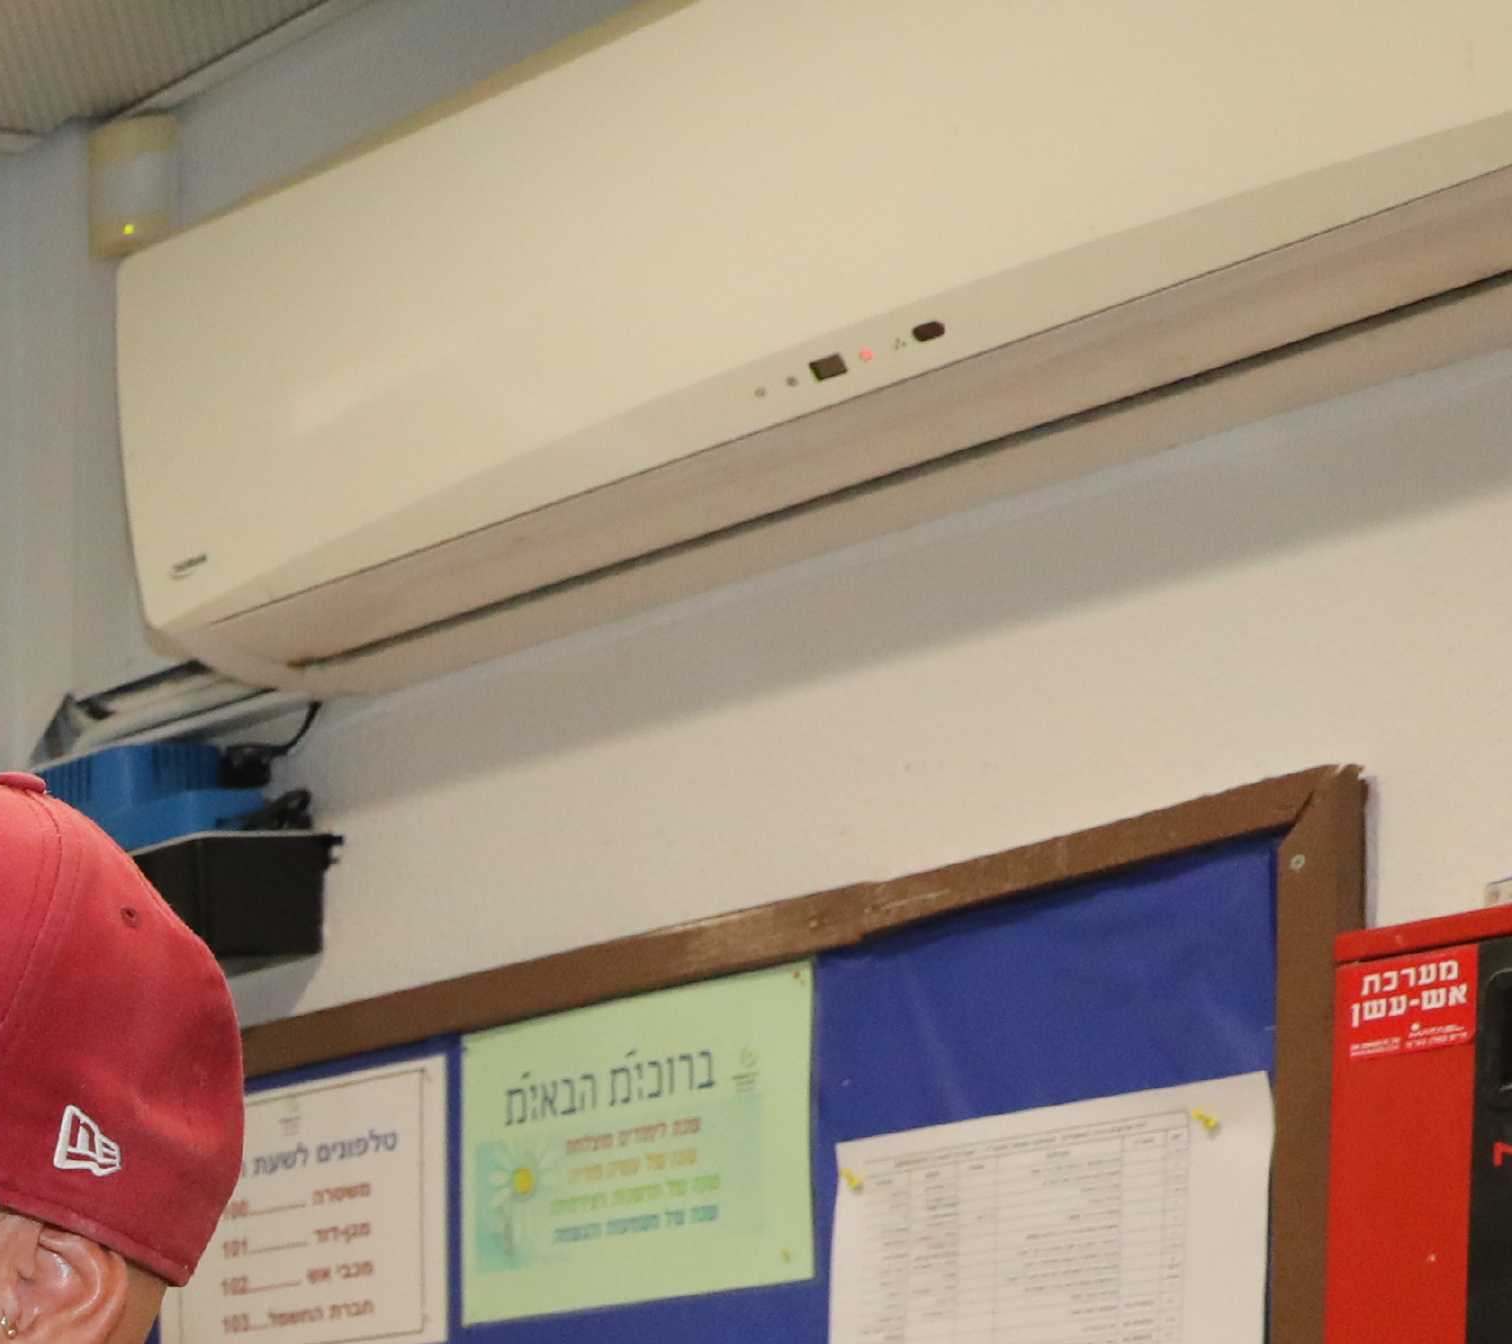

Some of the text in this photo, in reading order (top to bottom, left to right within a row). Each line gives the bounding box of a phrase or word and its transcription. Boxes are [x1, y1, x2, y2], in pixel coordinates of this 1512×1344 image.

[1361, 959, 1459, 996] מערכת
[1351, 983, 1468, 1028] אש-עשן
[253, 1142, 309, 1176] לשעת
[316, 1129, 399, 1163] טלפונים
[312, 1182, 371, 1205] משטרה
[222, 1260, 374, 1296] מכבי אש 102
[328, 1299, 375, 1319] חברת
